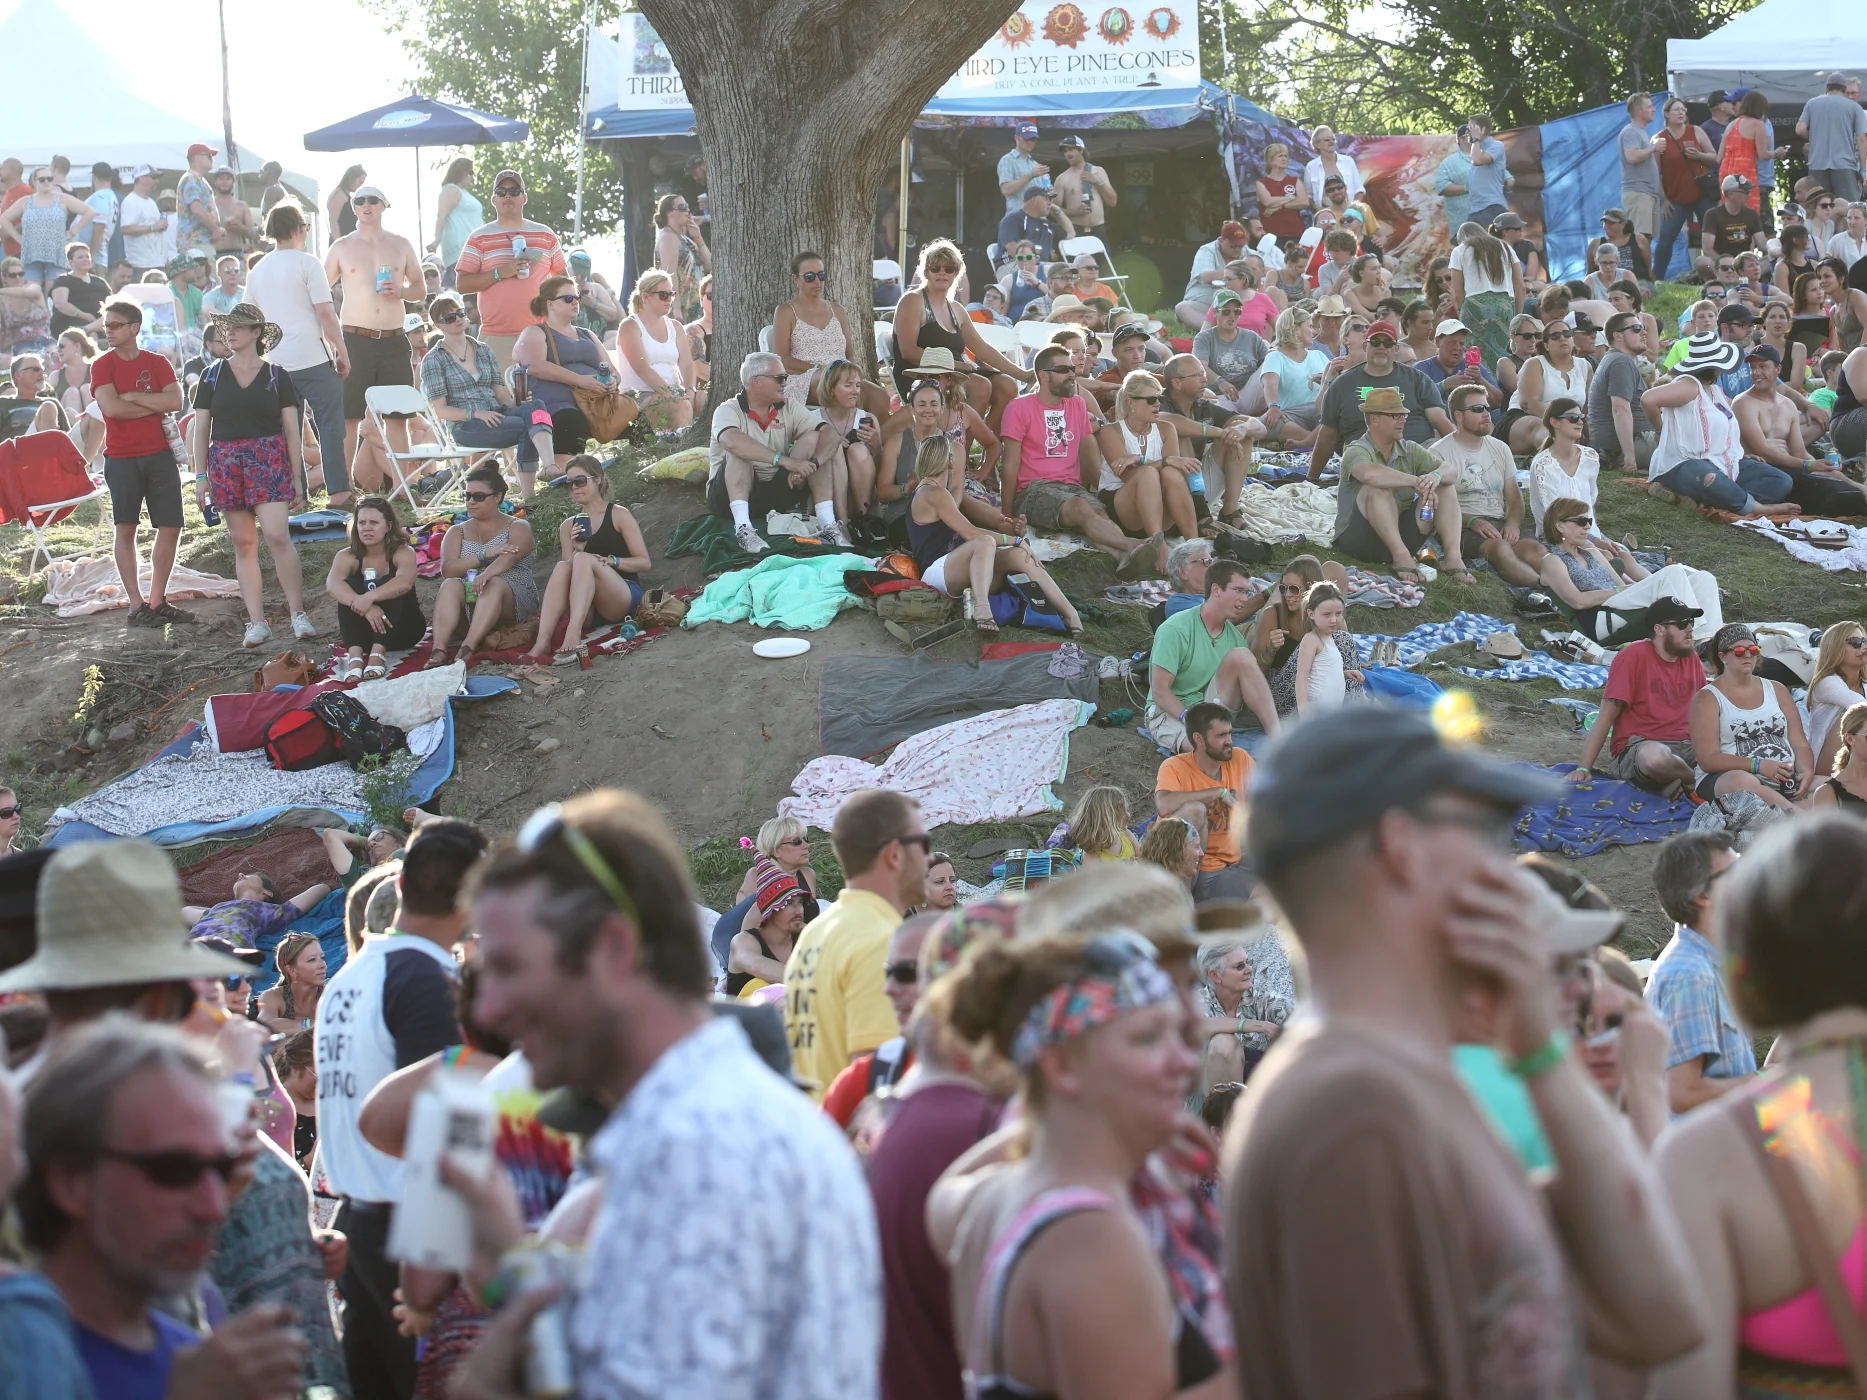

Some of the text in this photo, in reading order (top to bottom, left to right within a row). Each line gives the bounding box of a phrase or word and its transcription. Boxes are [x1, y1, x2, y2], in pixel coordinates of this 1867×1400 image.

[956, 49, 1195, 77] HIRD EYE PINECONES
[626, 76, 684, 95] THIRD
[995, 80, 1015, 89] BUY
[1020, 80, 1028, 89] A
[1063, 75, 1098, 87] PLANT
[1102, 76, 1109, 85] A
